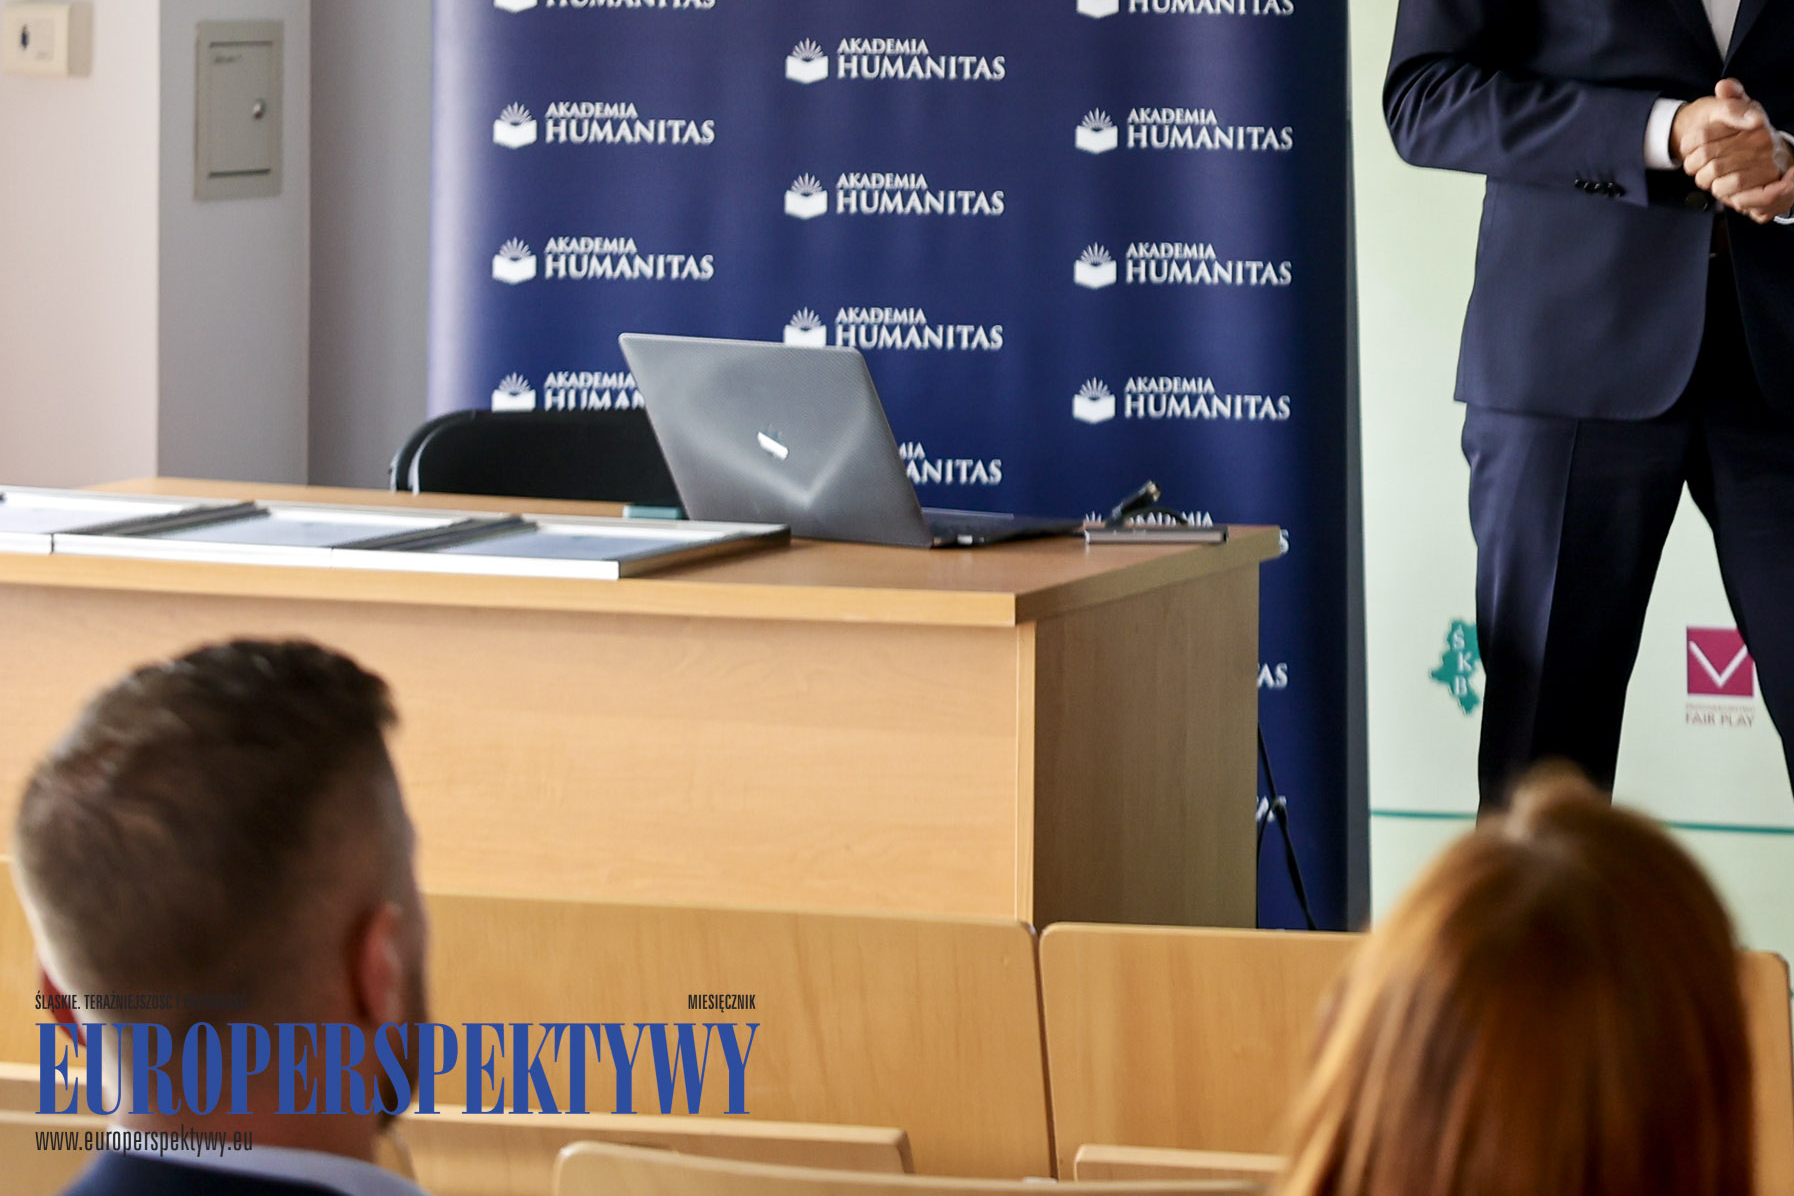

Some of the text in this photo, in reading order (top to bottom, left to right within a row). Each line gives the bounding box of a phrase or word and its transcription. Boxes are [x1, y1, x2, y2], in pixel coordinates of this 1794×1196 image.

[836, 37, 929, 57] AKADEMIA
[837, 56, 1006, 80] HUMANITAS
[545, 101, 639, 120] AKADEMIA
[1127, 107, 1218, 126] AKADEMIA
[545, 120, 715, 145] HUMANITAS
[1127, 126, 1293, 151] HUMANITAS
[836, 172, 928, 192] AKADEMIA
[836, 191, 1005, 215] HUMANITAS
[544, 236, 638, 255] AKADEMIA
[1126, 242, 1217, 261] AKADEMIA
[545, 254, 714, 280] HUMANITAS
[1126, 260, 1292, 286] HUMANITAS
[835, 307, 927, 326] AKADEMIA
[835, 325, 1004, 351] HUMANITAS
[543, 371, 637, 389] AKADEMIA
[1125, 376, 1215, 395] AKADEMIA
[1124, 395, 1291, 420] HUMANITAS
[905, 458, 1003, 484] ANITAS
